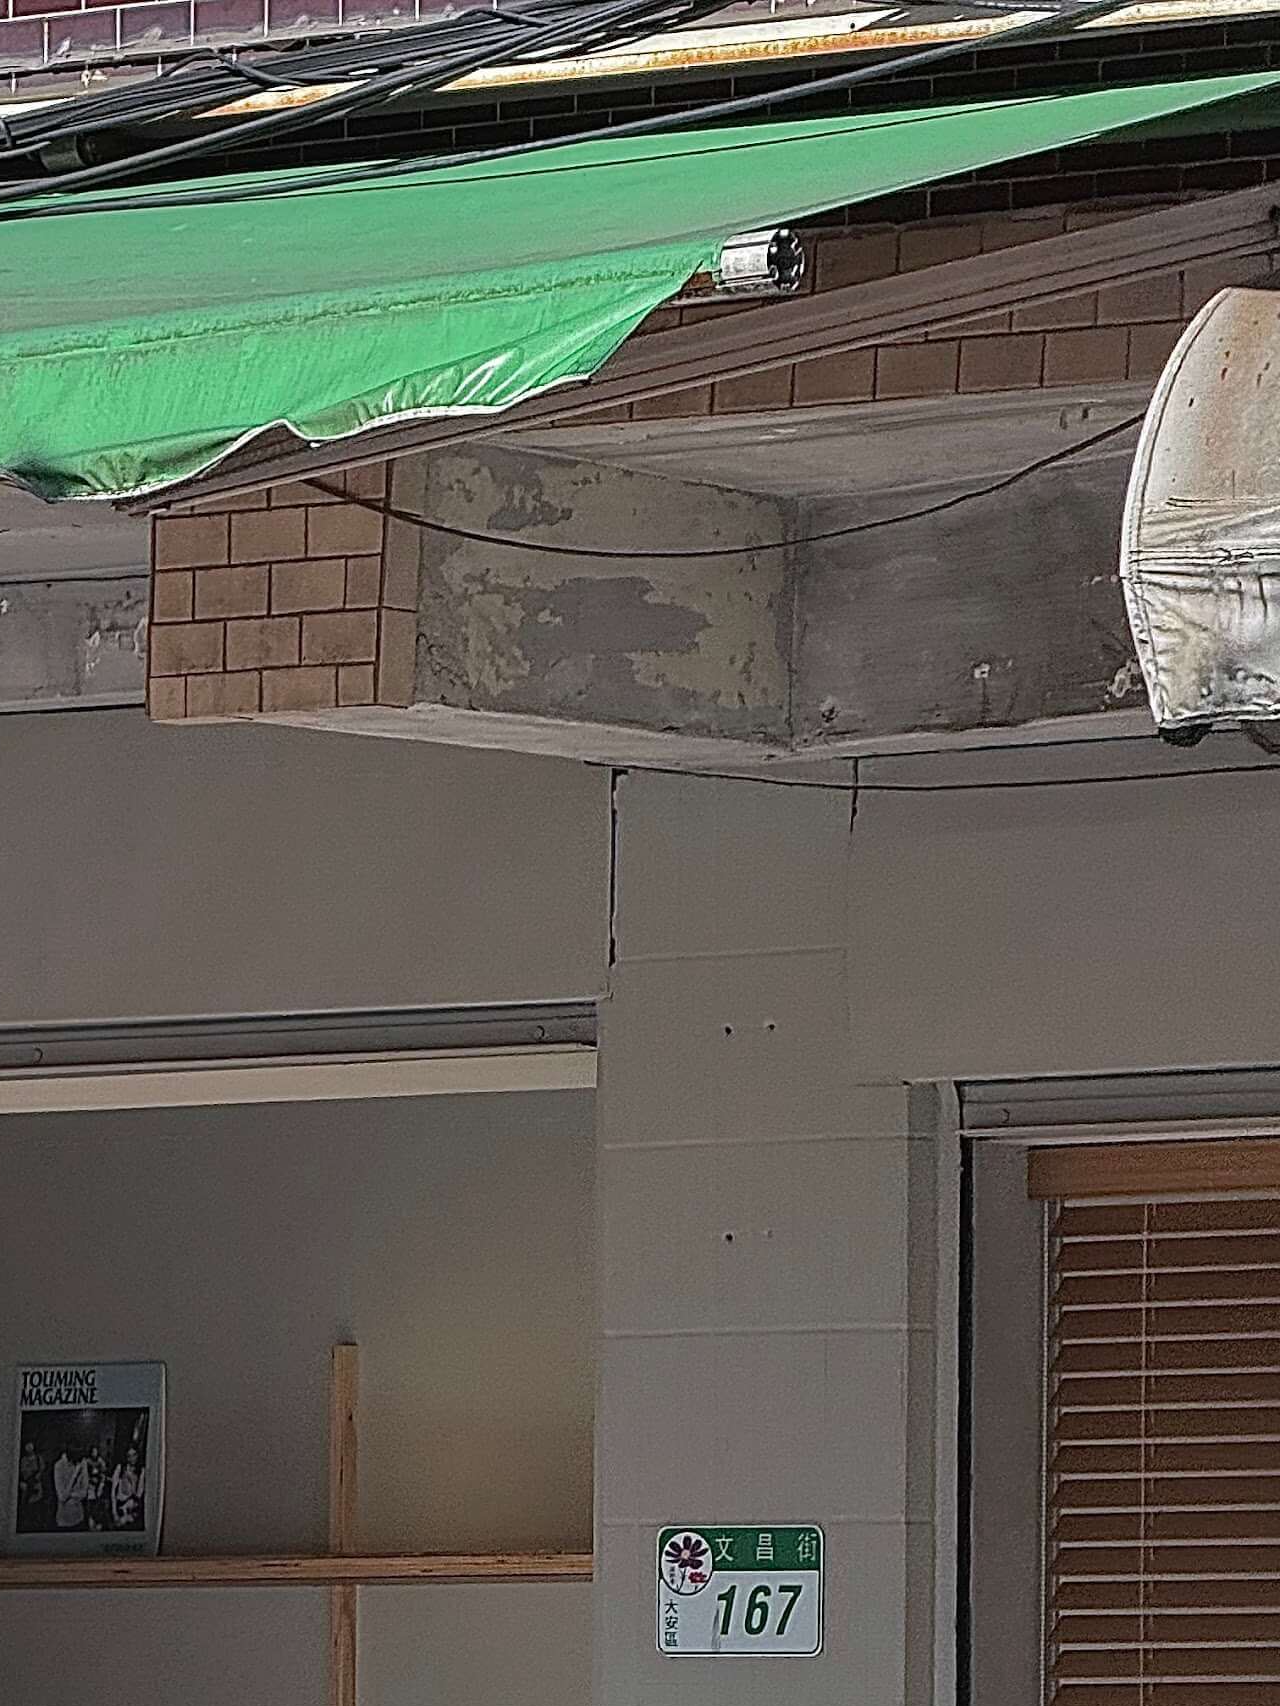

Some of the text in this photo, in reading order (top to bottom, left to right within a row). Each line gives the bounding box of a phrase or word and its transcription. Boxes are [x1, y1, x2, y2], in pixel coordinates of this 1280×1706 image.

[20, 1387, 99, 1406] MAGAZINE
[715, 1532, 818, 1562] 文昌街
[664, 1599, 679, 1647] 大安區
[716, 1584, 803, 1636] 167
